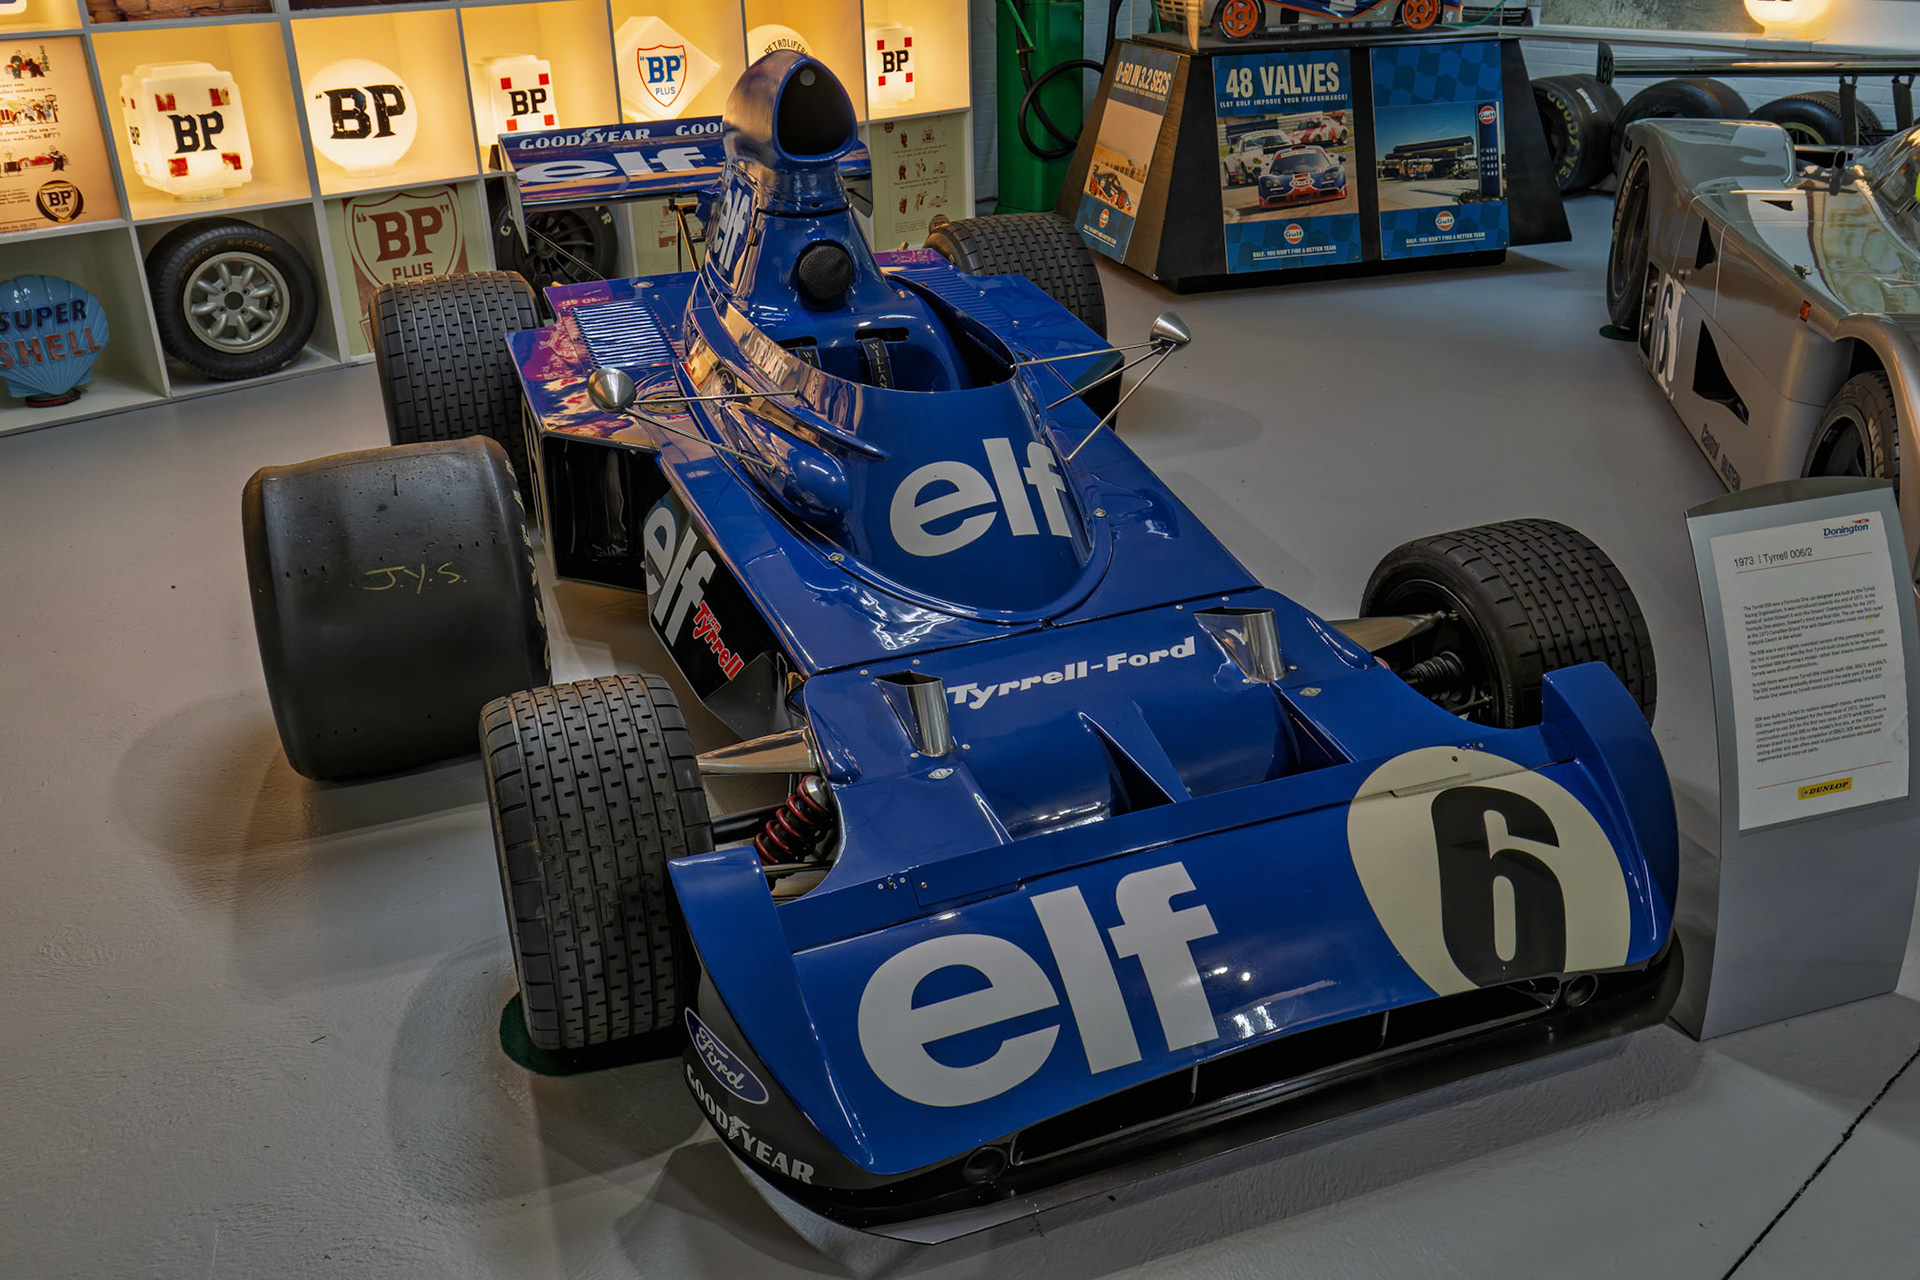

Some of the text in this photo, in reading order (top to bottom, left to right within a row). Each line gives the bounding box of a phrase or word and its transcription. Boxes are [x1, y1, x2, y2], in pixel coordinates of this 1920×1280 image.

[764, 38, 808, 55] PETROLIFER
[881, 50, 909, 74] BP
[655, 86, 676, 95] PLUS
[1116, 61, 1133, 84] 0-60
[1130, 64, 1142, 86] IN
[1139, 67, 1153, 90] 3.2
[1150, 70, 1172, 95] SECS
[1226, 62, 1340, 98] 48 VALVES
[508, 88, 546, 116] BP
[1302, 94, 1348, 102] PERFORMANCE)
[129, 126, 140, 146] BP
[166, 110, 224, 154] BP
[517, 146, 706, 182] elf
[714, 187, 750, 271] elf
[392, 262, 434, 280] PLUS
[890, 437, 1073, 557] elf
[1823, 524, 1868, 536] Donington
[1734, 547, 1812, 567] 1973 Tyrrell 006/2
[644, 507, 716, 647] elf
[692, 600, 745, 682] Tyrrell
[946, 636, 1196, 710] Tyrrell-Ford
[1809, 781, 1849, 794] DUNLOP
[1430, 786, 1567, 989] 6
[858, 861, 1219, 1107] elf
[696, 1026, 745, 1090] Ford
[687, 1064, 815, 1185] GOODYEAR
